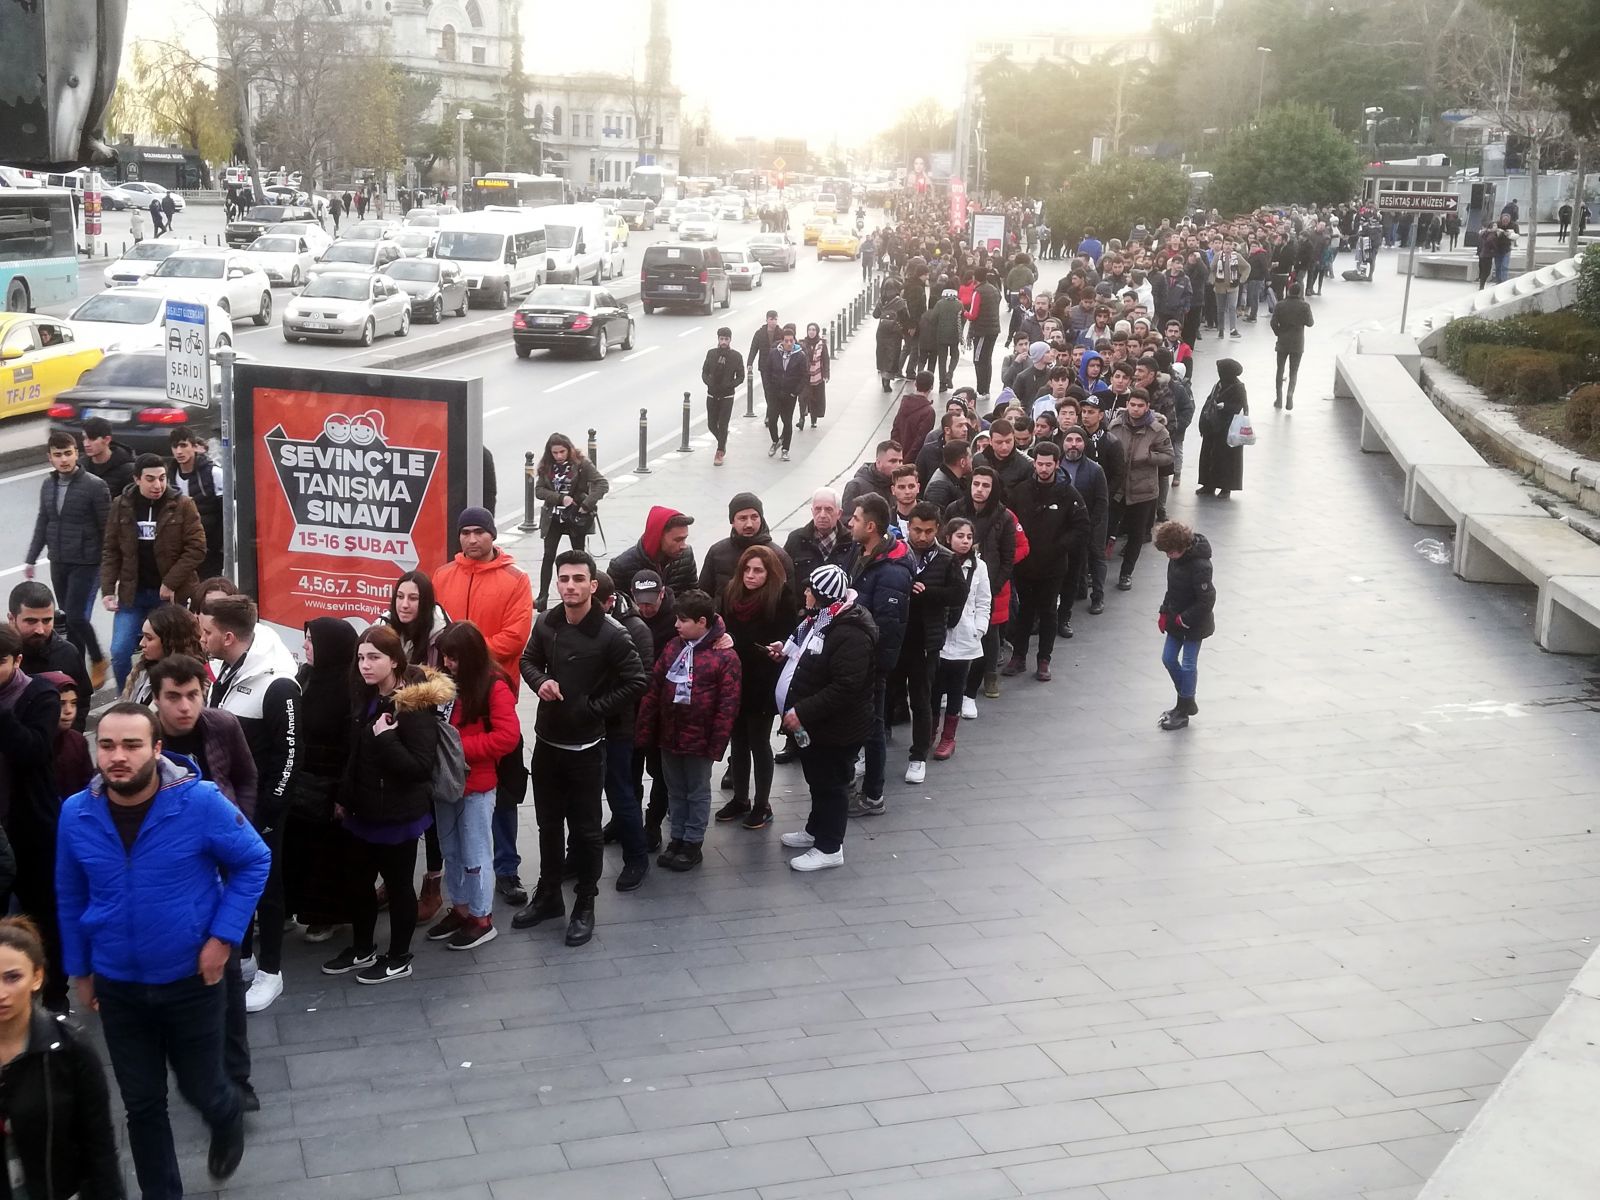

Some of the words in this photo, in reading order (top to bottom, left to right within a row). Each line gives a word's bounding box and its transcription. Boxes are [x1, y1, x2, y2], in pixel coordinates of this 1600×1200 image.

[1380, 195, 1410, 207] BEŞİKTAŞ
[1411, 197, 1420, 207] JK
[1421, 196, 1446, 208] MÜZESİ
[171, 361, 202, 379] ŞERİDİ
[6, 386, 26, 404] TFJ
[29, 384, 41, 399] 25
[170, 382, 204, 403] PAYLAŞ
[293, 471, 412, 503] TANIŞMA
[307, 500, 400, 529] SINAVI
[298, 531, 340, 549] 15-16
[344, 536, 409, 555] ŞUBAT
[298, 575, 351, 595] 4,5,6,7.
[286, 698, 296, 736] America
[286, 736, 296, 746] of
[284, 747, 296, 771] States
[273, 771, 291, 797] United
